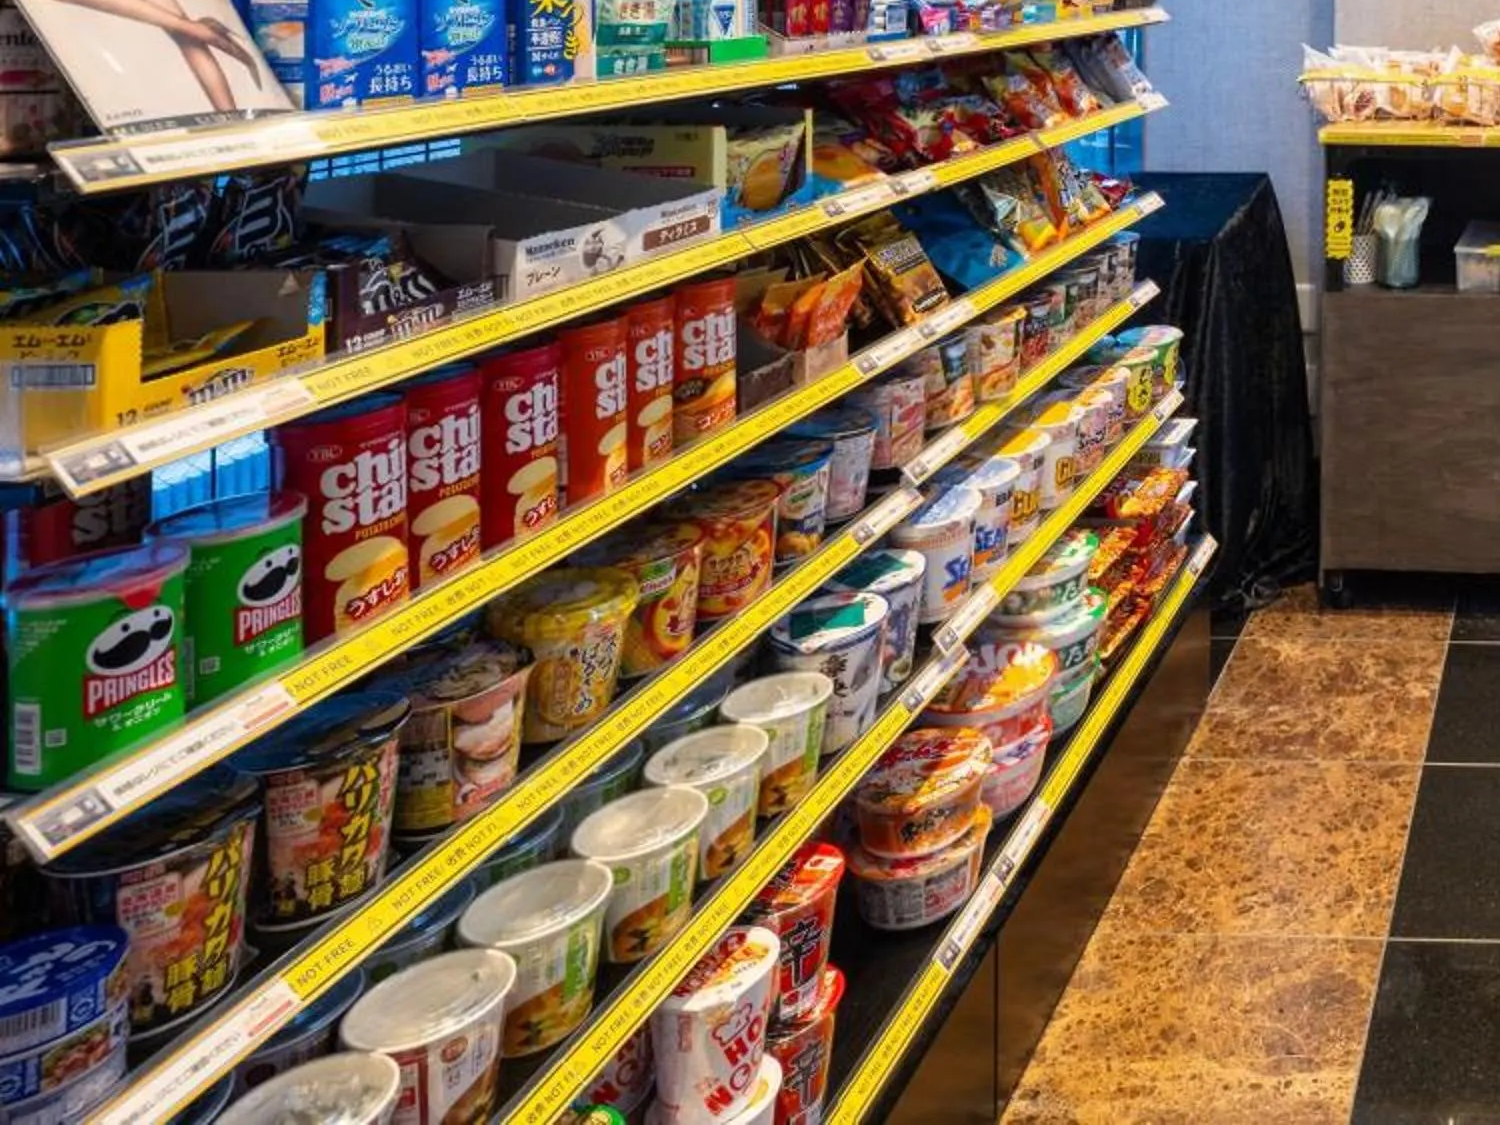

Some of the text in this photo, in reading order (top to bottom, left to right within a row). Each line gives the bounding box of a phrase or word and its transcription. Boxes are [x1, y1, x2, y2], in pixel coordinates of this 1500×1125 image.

[368, 76, 413, 94] 長持ち
[466, 66, 504, 84] 長持ち
[344, 334, 362, 353] 12
[682, 306, 737, 345] chi
[635, 328, 674, 365] ch
[682, 336, 737, 371] sta
[506, 372, 558, 422] ch
[635, 365, 674, 393] st
[409, 403, 480, 459] chi
[506, 414, 558, 455] sta
[319, 437, 407, 499] chi
[410, 444, 480, 493] sta
[321, 480, 407, 536] sta
[526, 495, 558, 526] うすし
[87, 651, 176, 714] PRINGLES
[295, 936, 355, 987] NOT FREE
